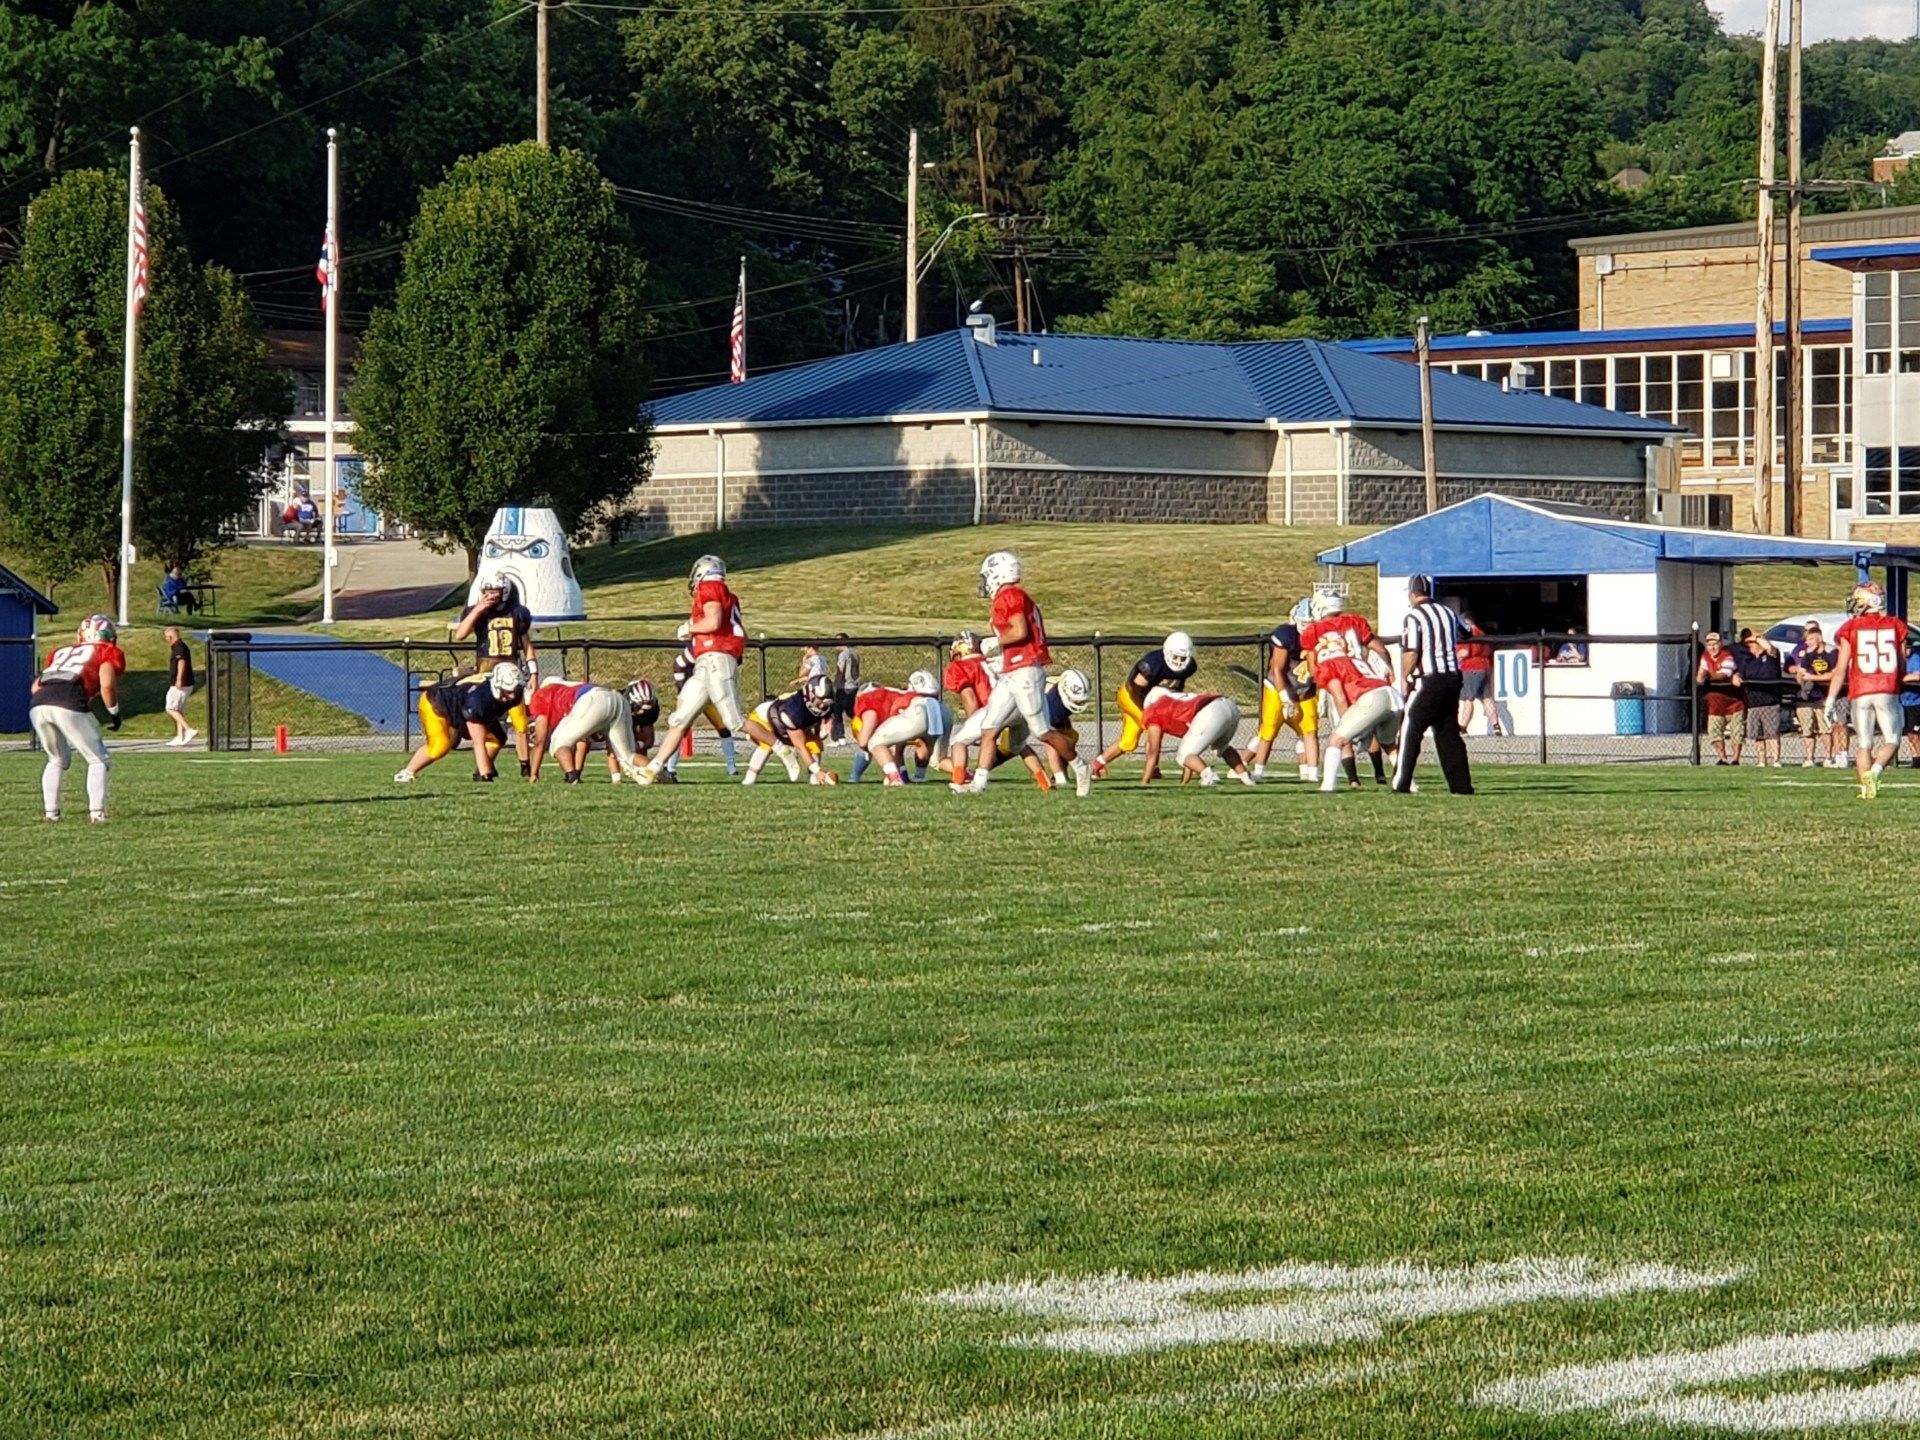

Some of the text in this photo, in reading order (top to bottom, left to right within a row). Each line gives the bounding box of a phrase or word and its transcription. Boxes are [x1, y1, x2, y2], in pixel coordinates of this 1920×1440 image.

[488, 629, 513, 657] 12
[1856, 628, 1898, 674] 55
[1497, 652, 1529, 698] 10
